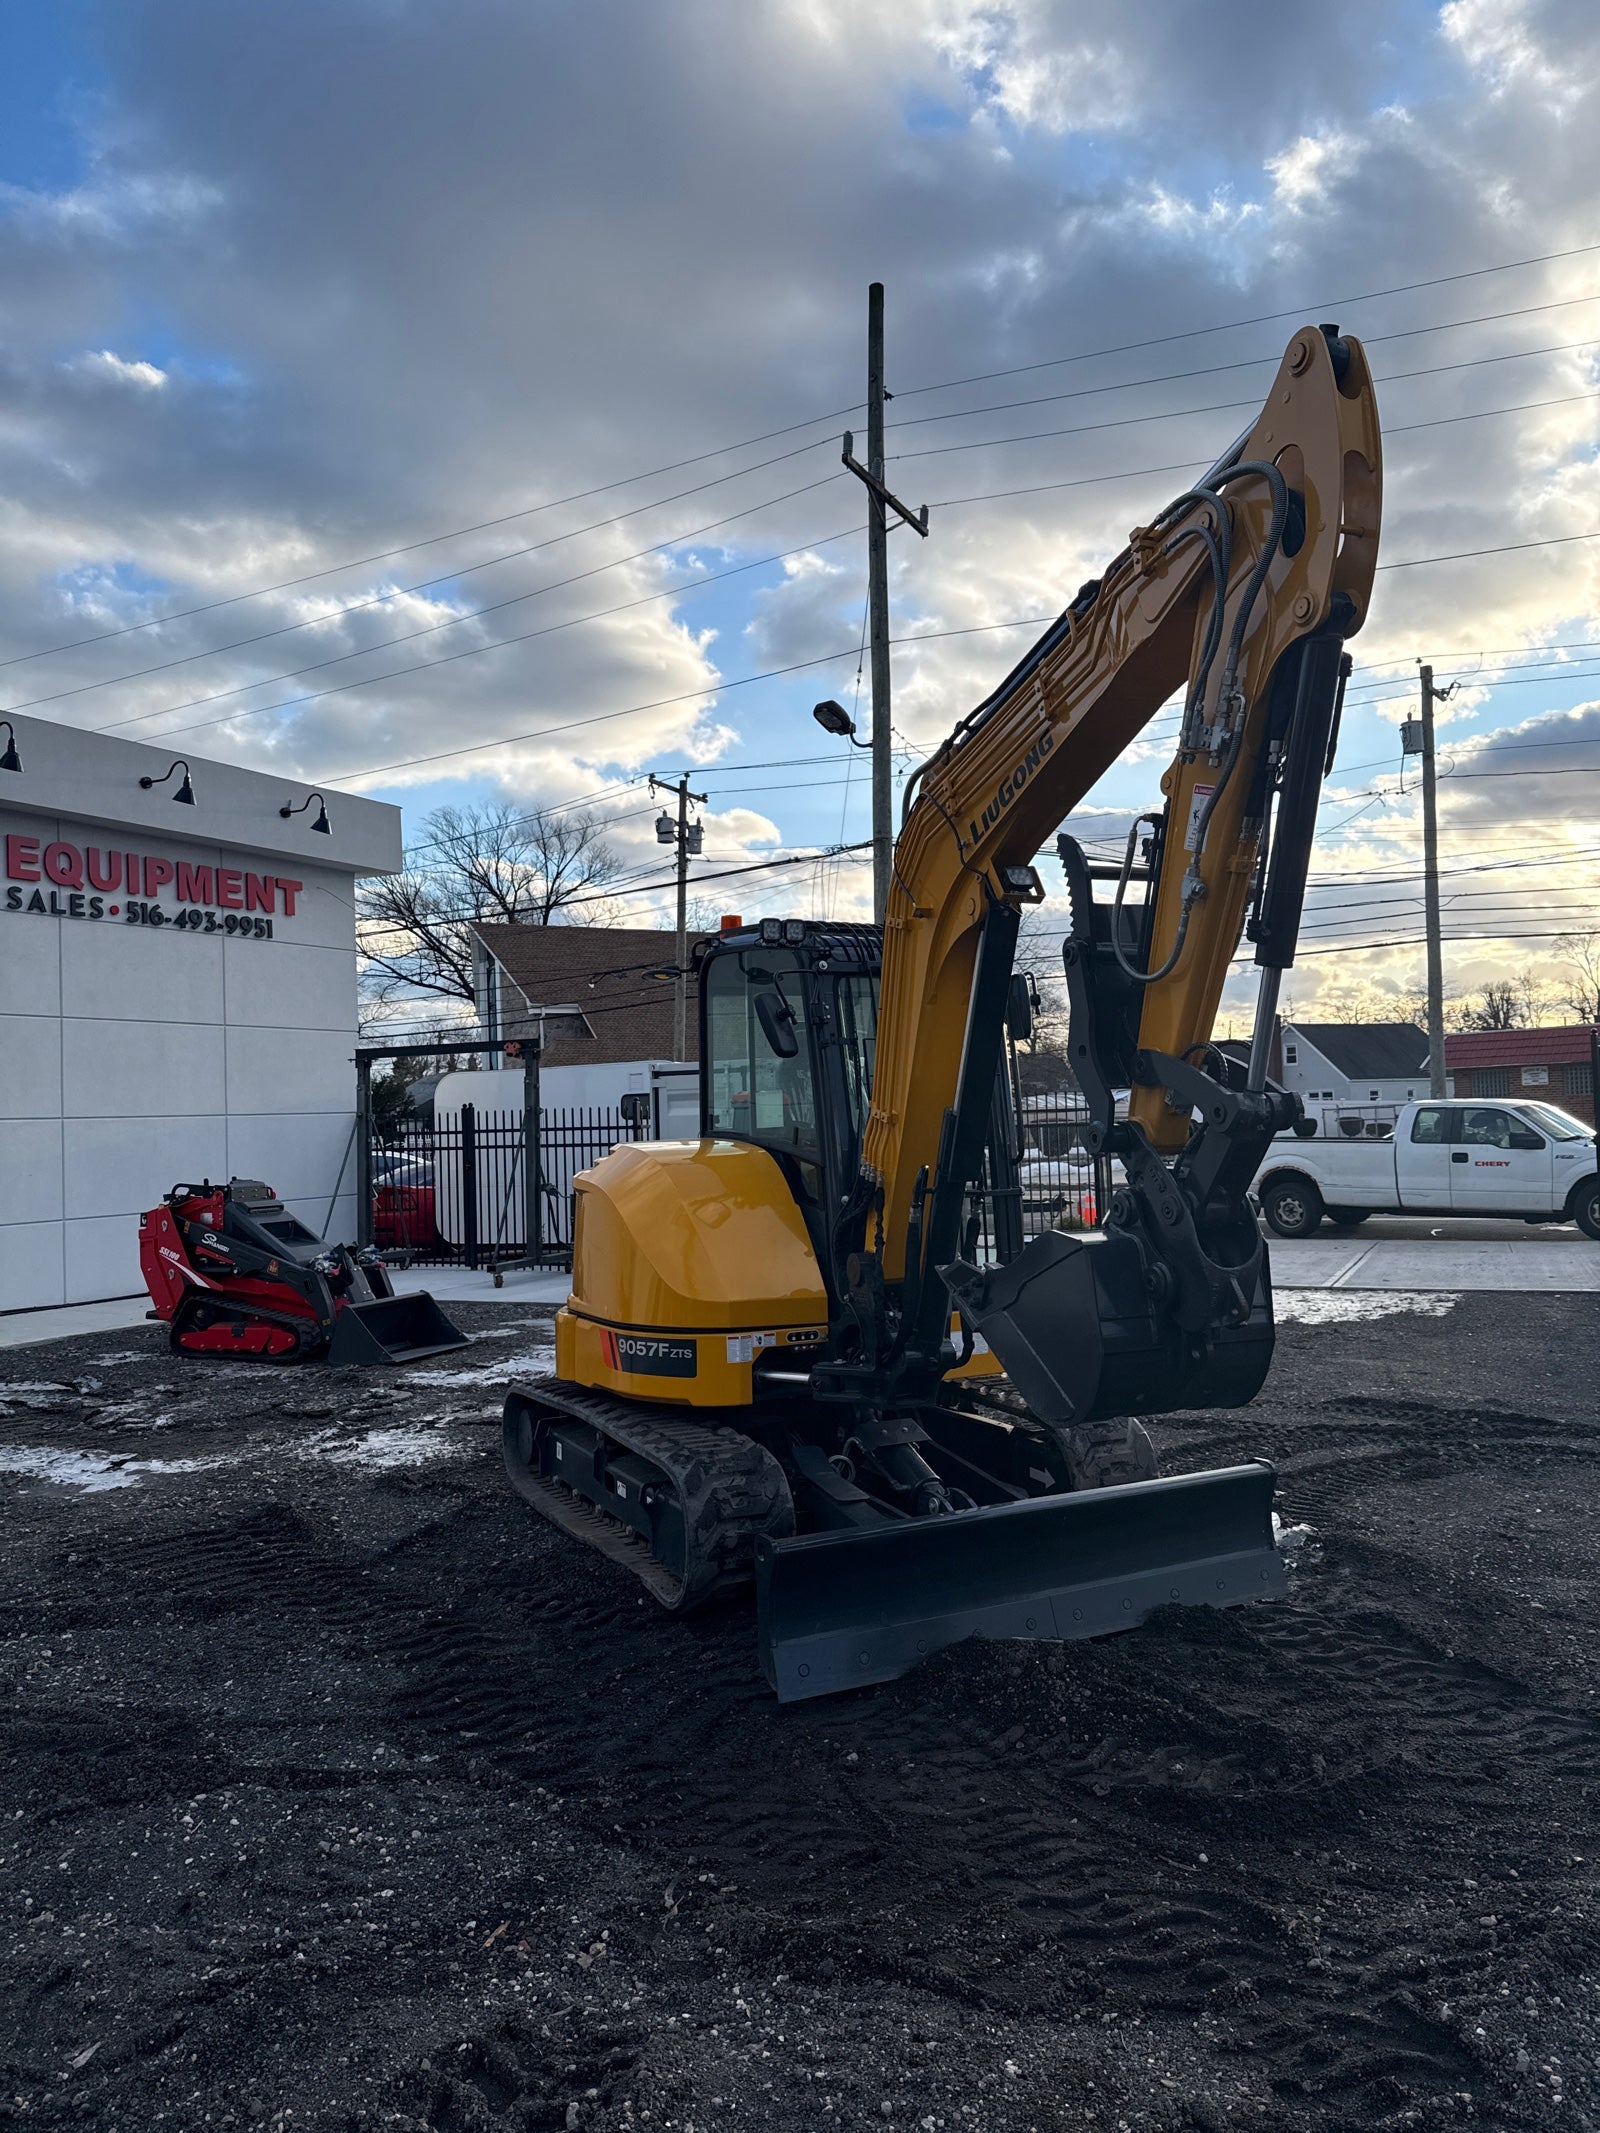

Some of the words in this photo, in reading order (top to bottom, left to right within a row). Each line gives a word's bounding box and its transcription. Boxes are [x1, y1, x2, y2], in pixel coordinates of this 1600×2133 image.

[970, 728, 1054, 845] LIUGONG
[7, 834, 303, 916] EQUIPMENT
[7, 886, 104, 919] SALES
[126, 901, 273, 938] 516-493-9951
